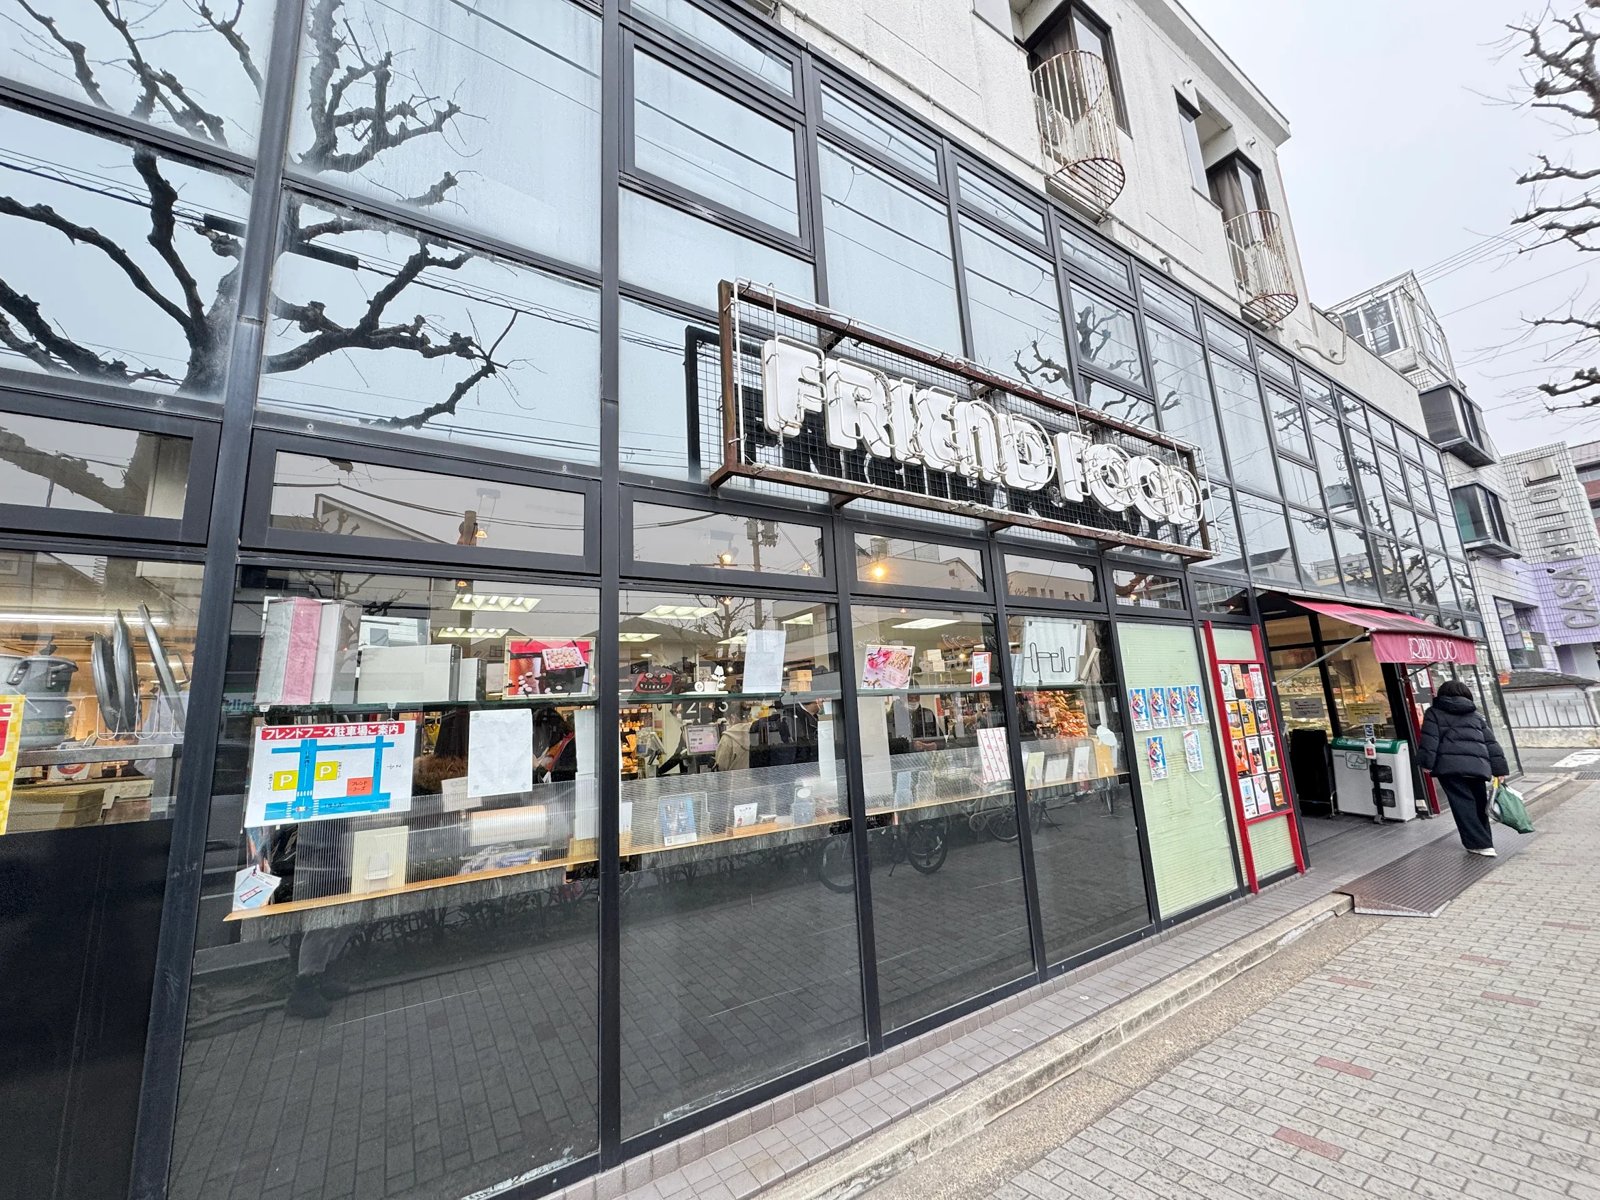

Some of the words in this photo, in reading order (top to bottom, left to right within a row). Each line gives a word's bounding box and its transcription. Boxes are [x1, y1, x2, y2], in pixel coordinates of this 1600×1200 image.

[761, 335, 1056, 492] FRIEND
[1552, 563, 1600, 629] CASA
[265, 725, 400, 739] フレンドフーズ駐車場ご案内
[320, 765, 332, 778] P
[280, 775, 293, 787] P
